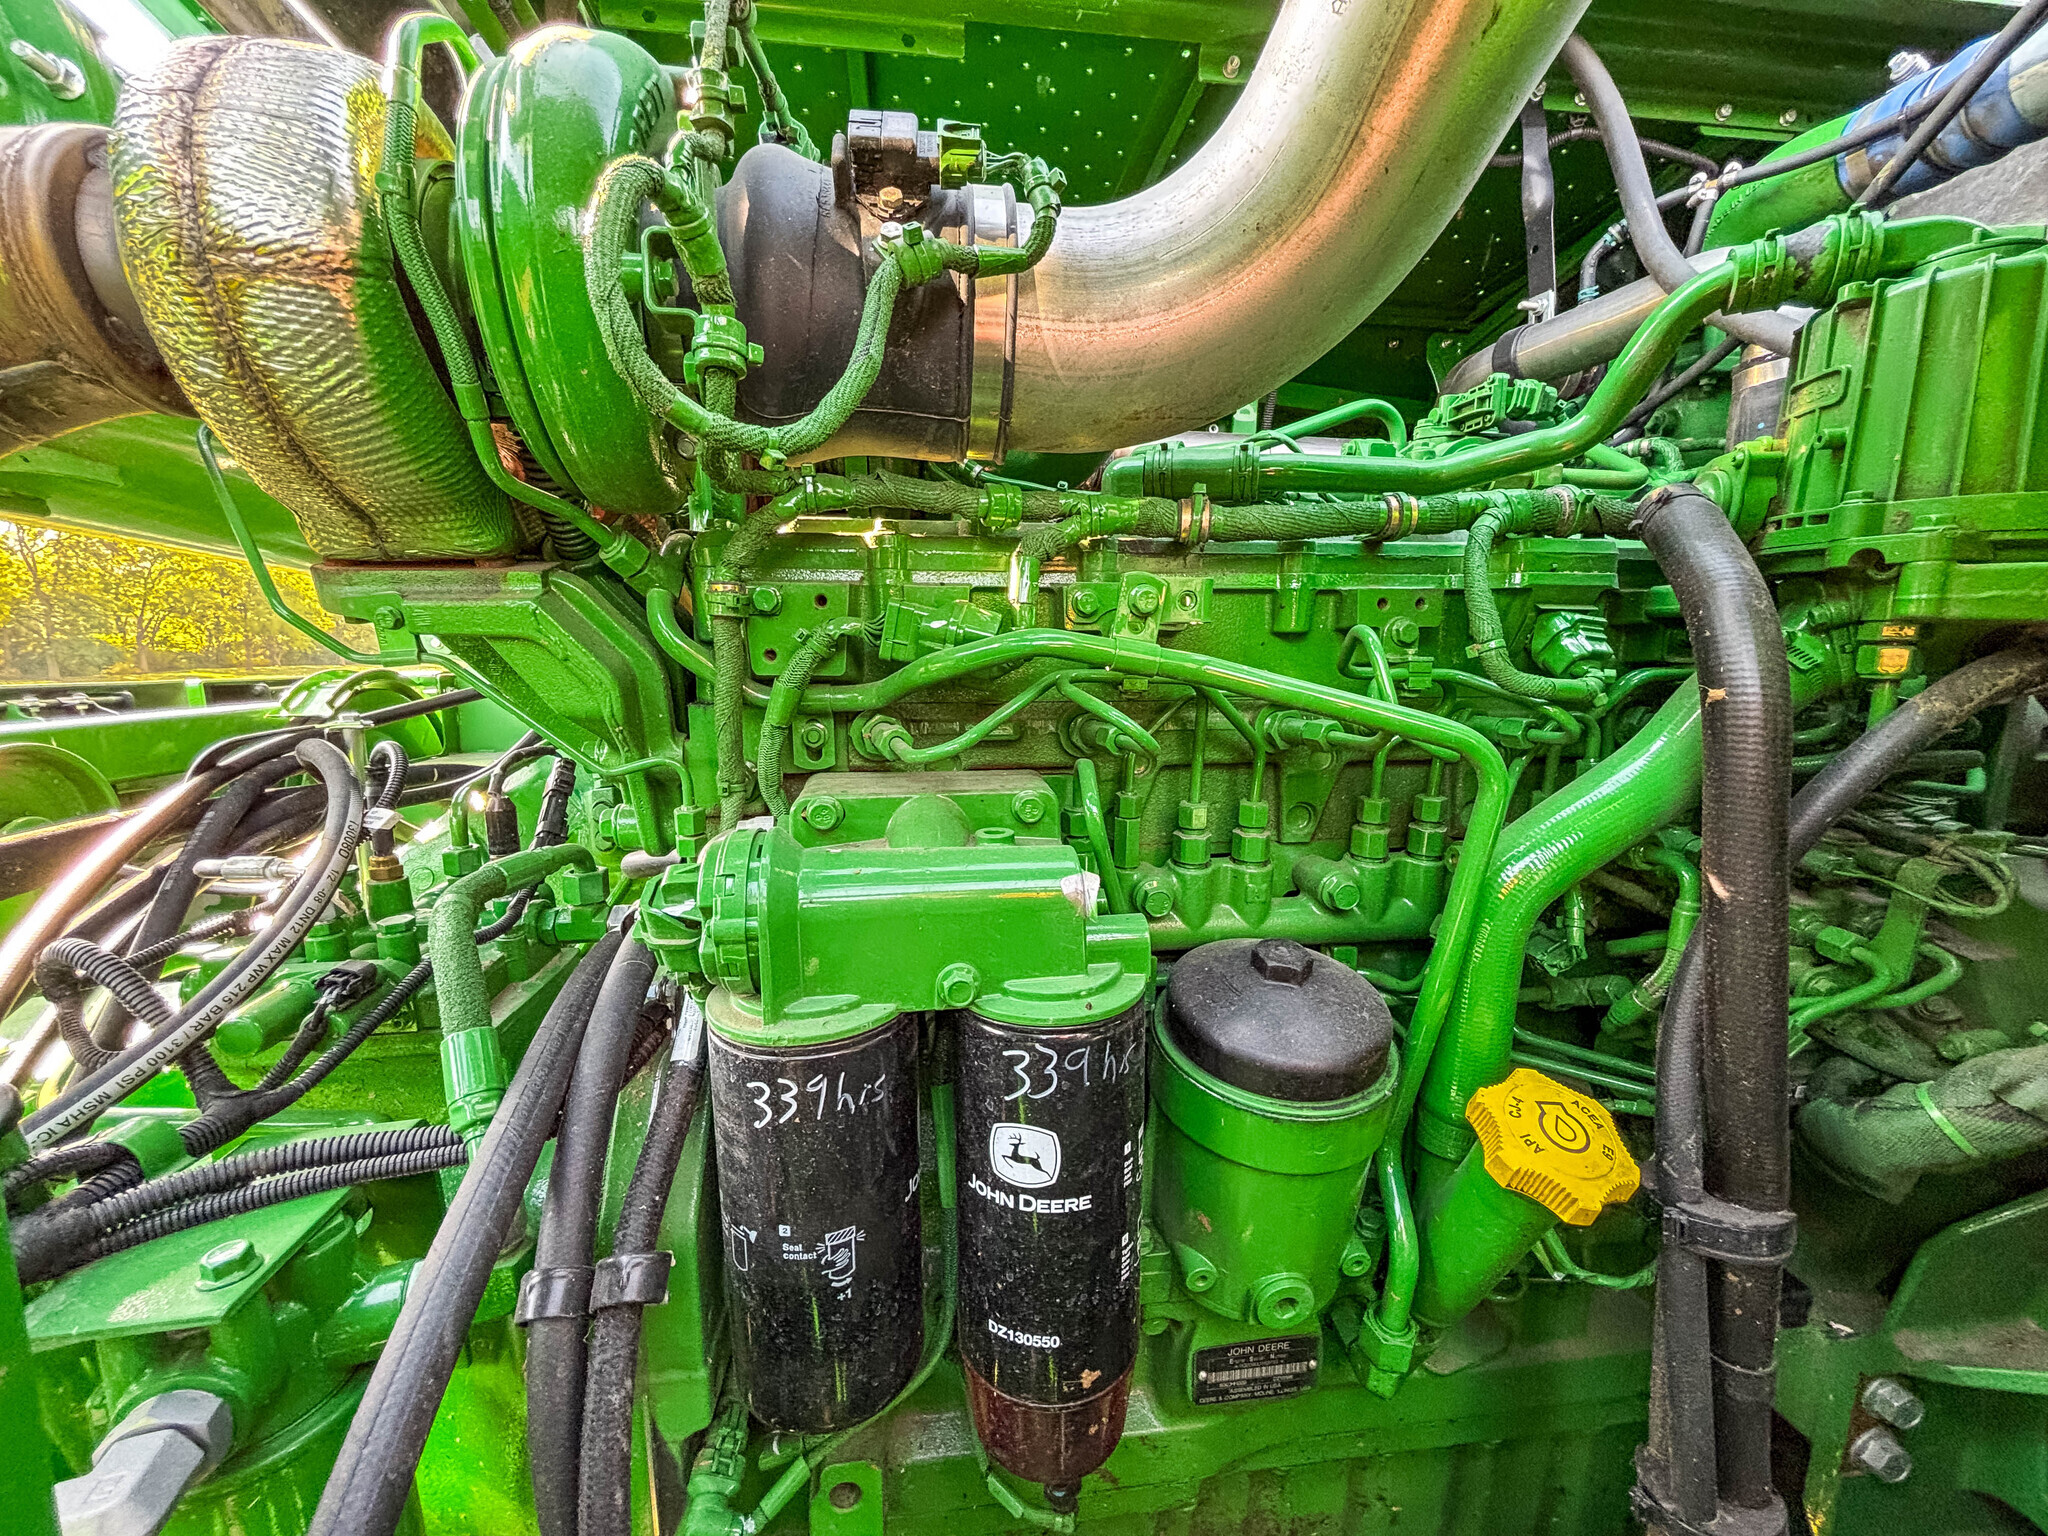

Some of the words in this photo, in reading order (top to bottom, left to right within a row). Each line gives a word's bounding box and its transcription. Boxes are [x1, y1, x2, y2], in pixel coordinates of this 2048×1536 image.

[313, 888, 327, 904] -08
[289, 906, 316, 934] DN12
[263, 936, 292, 963] MAX
[247, 963, 268, 983] WP
[221, 982, 247, 1005] 215
[189, 1004, 224, 1032] BAR
[146, 1037, 184, 1067] 3100
[115, 1066, 147, 1089] PSI
[1002, 1043, 1091, 1101] 339
[55, 1091, 112, 1128] MSHA
[1508, 1096, 1524, 1118] CJ-4
[1571, 1100, 1605, 1129] ACEA
[1601, 1144, 1615, 1161] E9
[1520, 1133, 1545, 1154] API
[968, 1173, 1015, 1209] JOHN
[1018, 1194, 1092, 1214] DEERE
[782, 1243, 803, 1252] Seal
[782, 1252, 818, 1261] contact
[988, 1318, 1061, 1349] DZ130550
[1227, 1345, 1255, 1357] JOHN
[1258, 1341, 1291, 1353] DEERE
